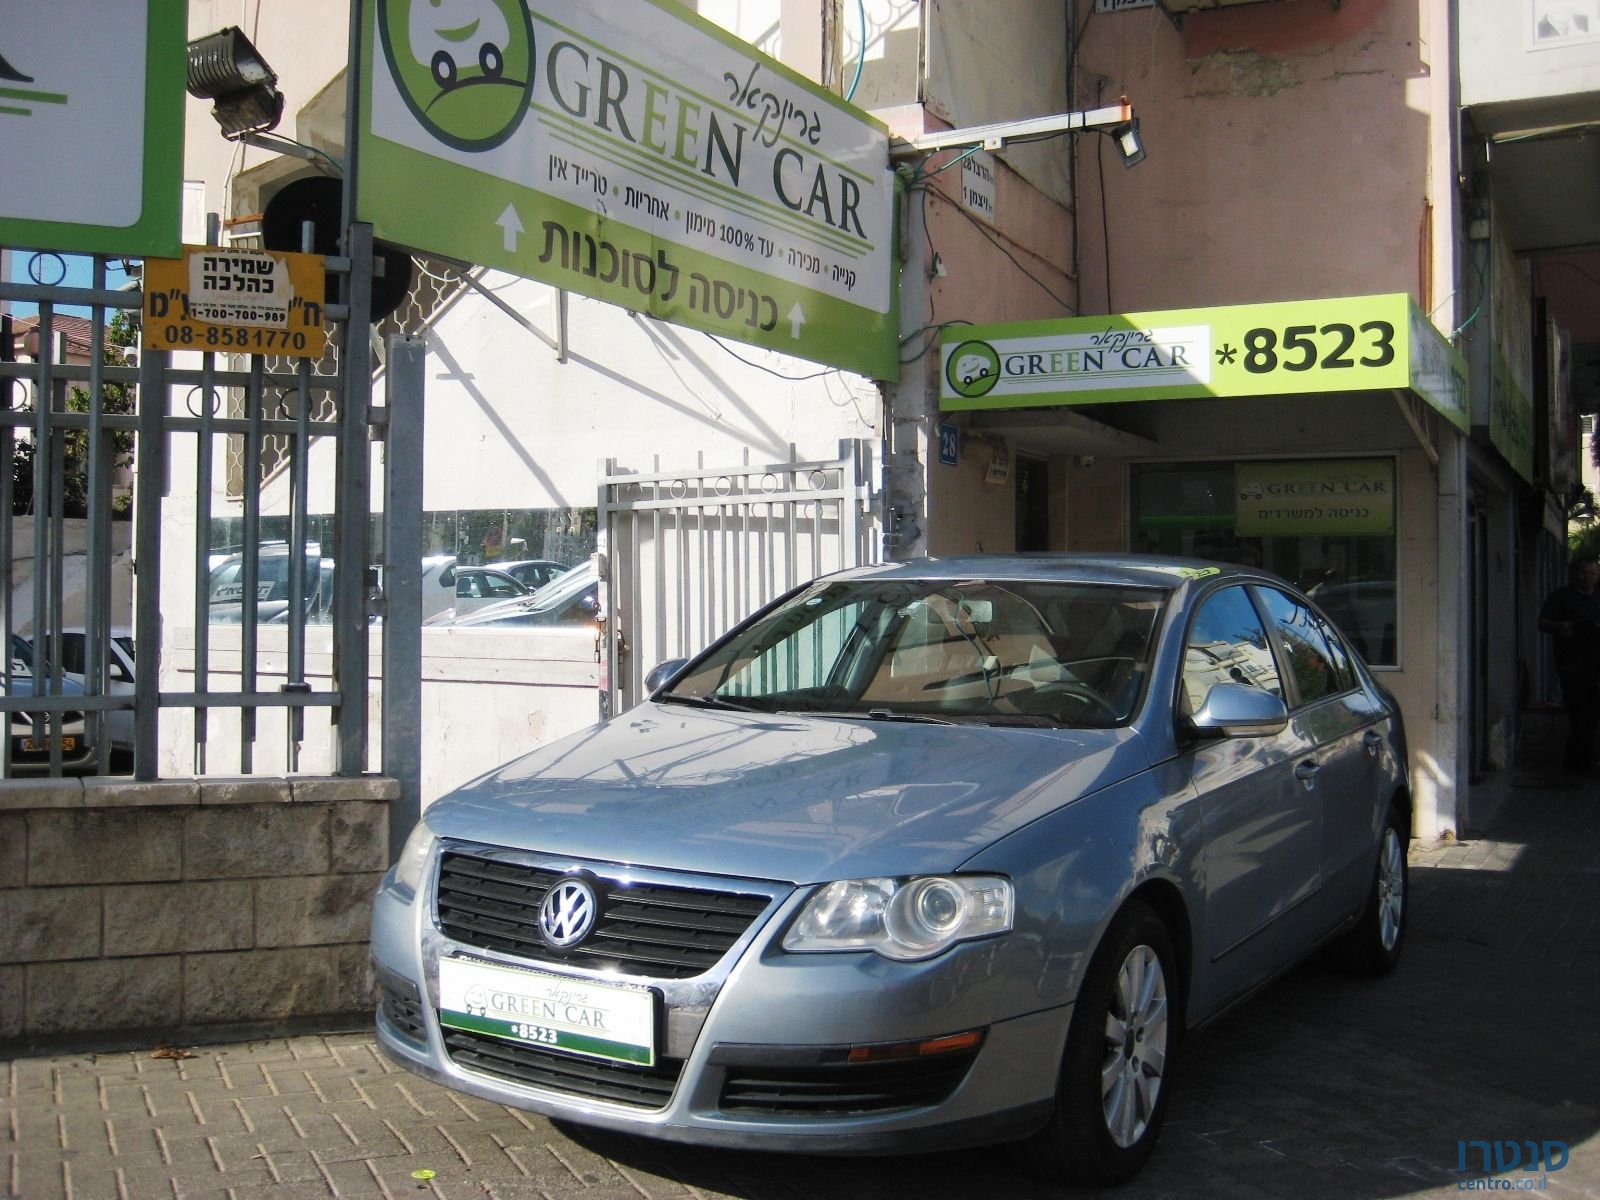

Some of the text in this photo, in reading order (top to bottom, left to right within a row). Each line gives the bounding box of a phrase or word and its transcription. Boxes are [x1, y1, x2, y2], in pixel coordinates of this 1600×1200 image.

[546, 41, 868, 240] GREEN CAR
[549, 154, 856, 291] קנייה מכירה עד 100% מימון אחריות טרייד אין
[203, 256, 275, 275] שמירה
[538, 220, 778, 331] כניסה לסוכנות
[203, 274, 275, 294] כהלכה
[191, 308, 286, 322] 1-700-700-989
[165, 324, 306, 350] 08-8581770
[1005, 343, 1191, 376] GREEN CAR
[942, 432, 956, 457] 28
[1345, 481, 1386, 493] CAR
[1258, 507, 1370, 520] כניסה למשרדים
[491, 992, 606, 1029] GREEN CAR
